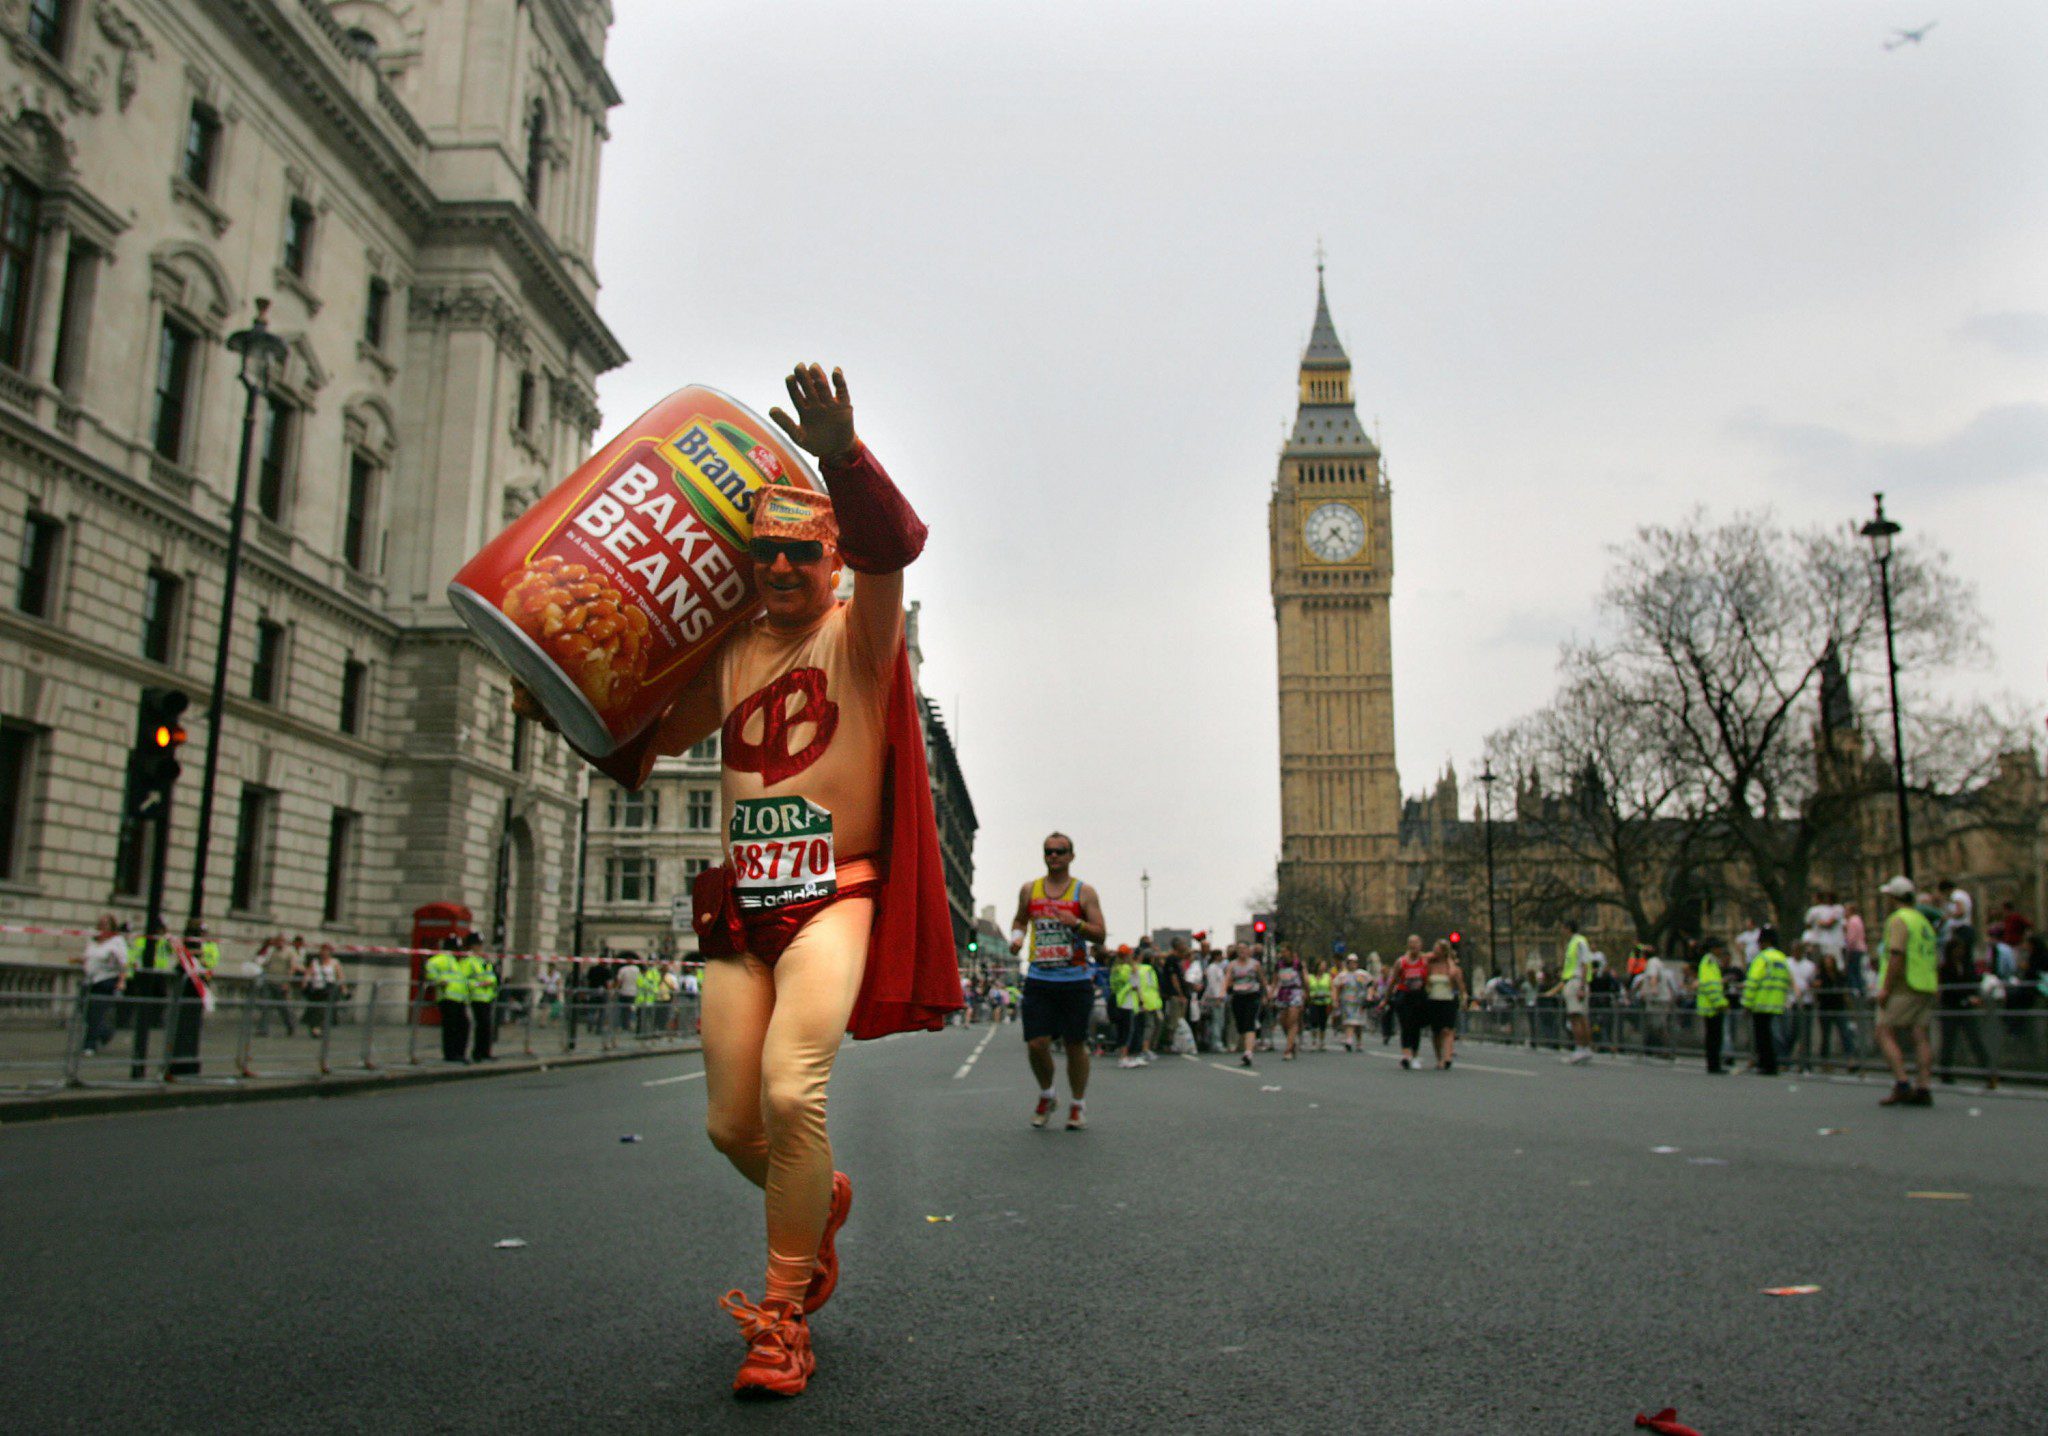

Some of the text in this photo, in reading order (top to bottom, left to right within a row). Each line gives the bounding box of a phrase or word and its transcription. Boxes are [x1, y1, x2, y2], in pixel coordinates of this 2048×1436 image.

[607, 461, 745, 611] BAKED
[673, 425, 755, 524] Brans
[573, 493, 714, 642] BEANS
